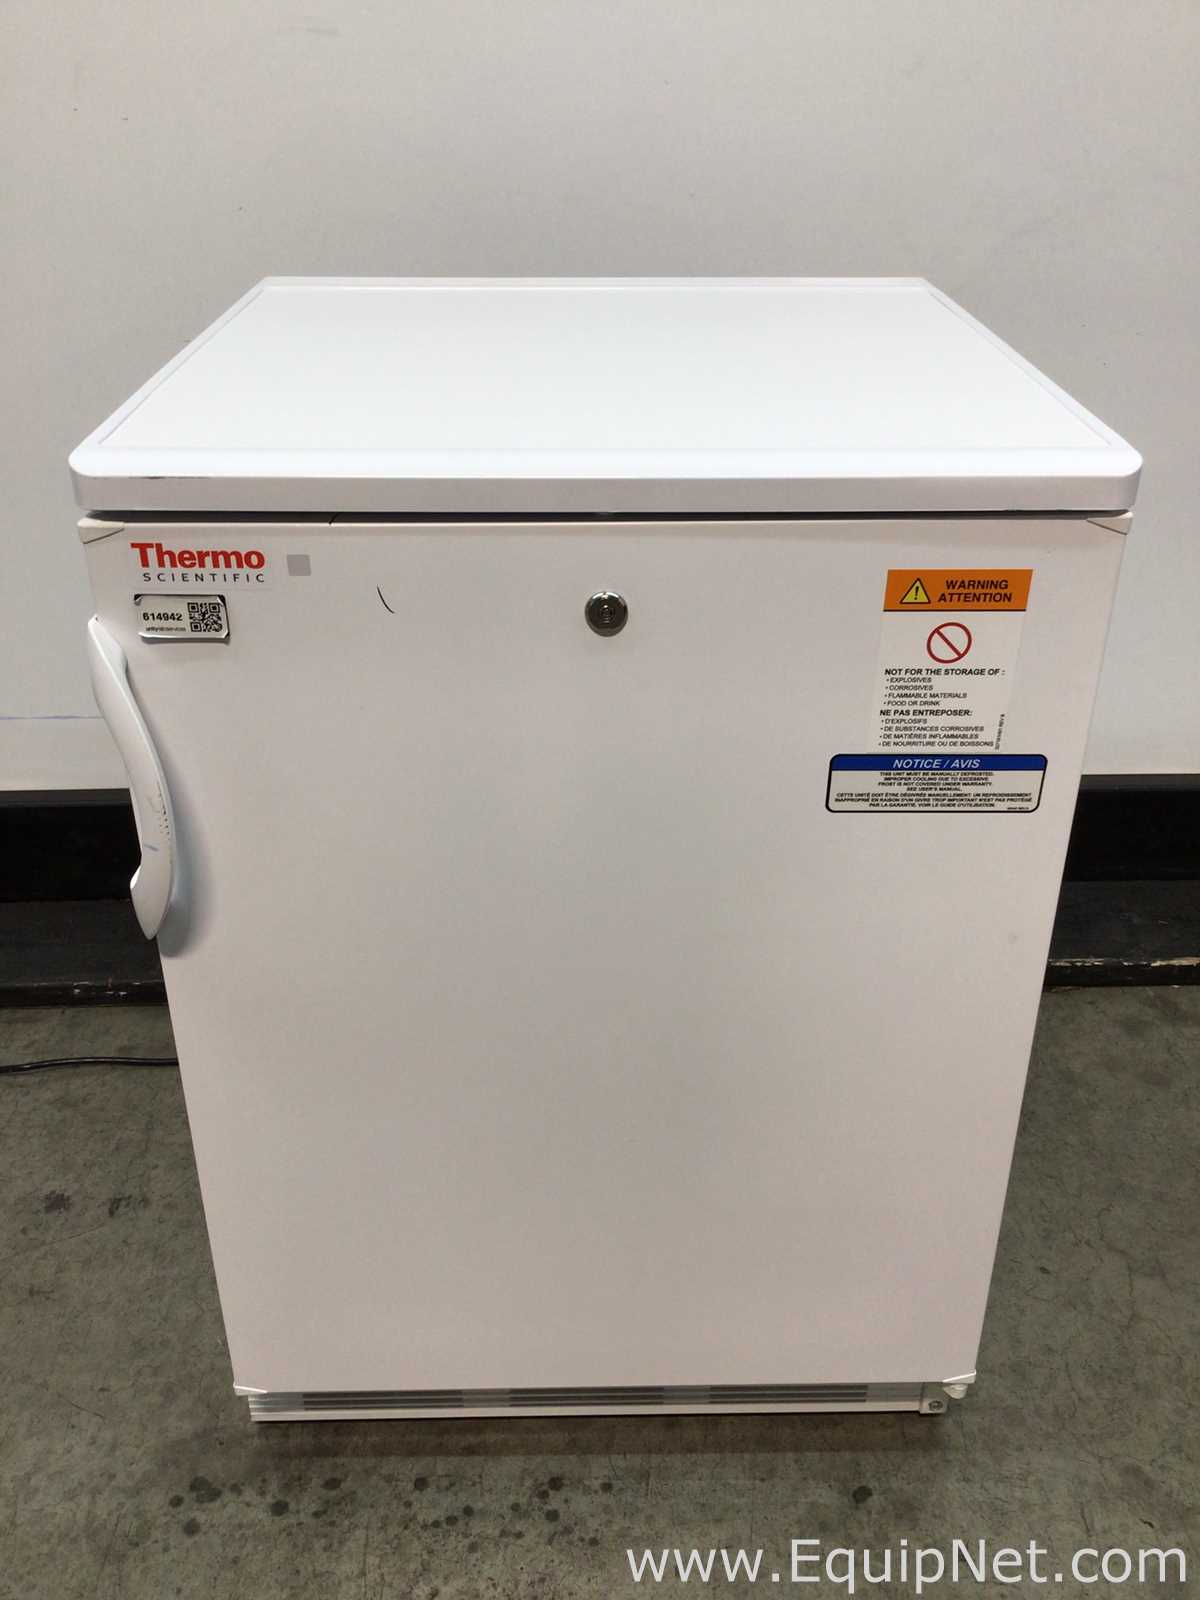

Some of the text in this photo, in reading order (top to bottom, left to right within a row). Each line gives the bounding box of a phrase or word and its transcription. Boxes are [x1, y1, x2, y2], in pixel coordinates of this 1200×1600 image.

[131, 543, 265, 569] Thermo
[143, 573, 265, 582] SCIENTIFIC
[945, 580, 1009, 590] WARNING
[938, 592, 1012, 603] ATTENTION
[142, 612, 183, 621] 614942
[884, 668, 902, 676] NOT
[905, 668, 923, 676] FOR
[925, 668, 942, 676] THE
[944, 668, 986, 676] STORAGE
[987, 668, 1001, 676] OF
[893, 759, 941, 769] NOTICE
[950, 759, 980, 769] AVIS
